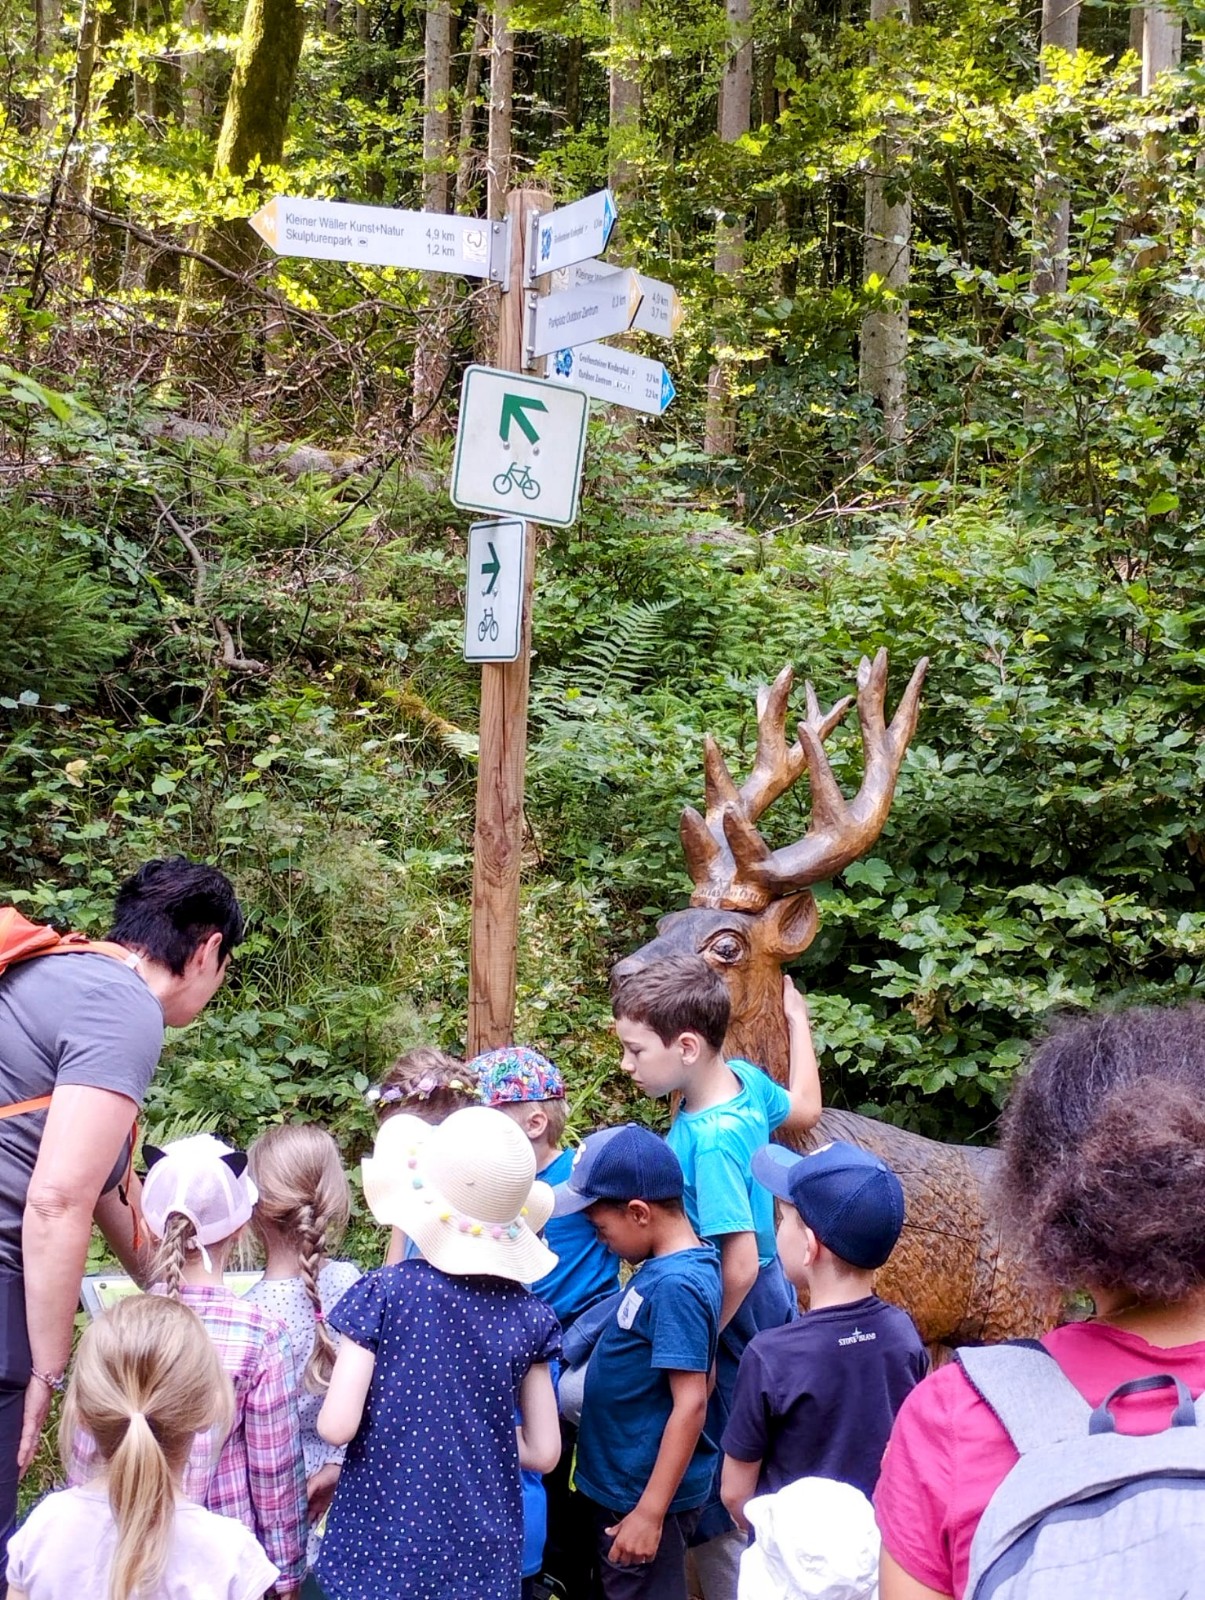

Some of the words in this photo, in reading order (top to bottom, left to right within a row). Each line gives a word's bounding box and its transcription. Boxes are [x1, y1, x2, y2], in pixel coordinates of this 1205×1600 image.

[285, 212, 317, 227] Kleiner
[319, 216, 348, 231] Wäller
[350, 220, 404, 237] Kunst+Natur
[425, 228, 440, 241] 4,9
[441, 229, 455, 242] km
[285, 228, 353, 248] Skulpturenpark
[426, 243, 440, 256] 1,2
[441, 245, 455, 257] km
